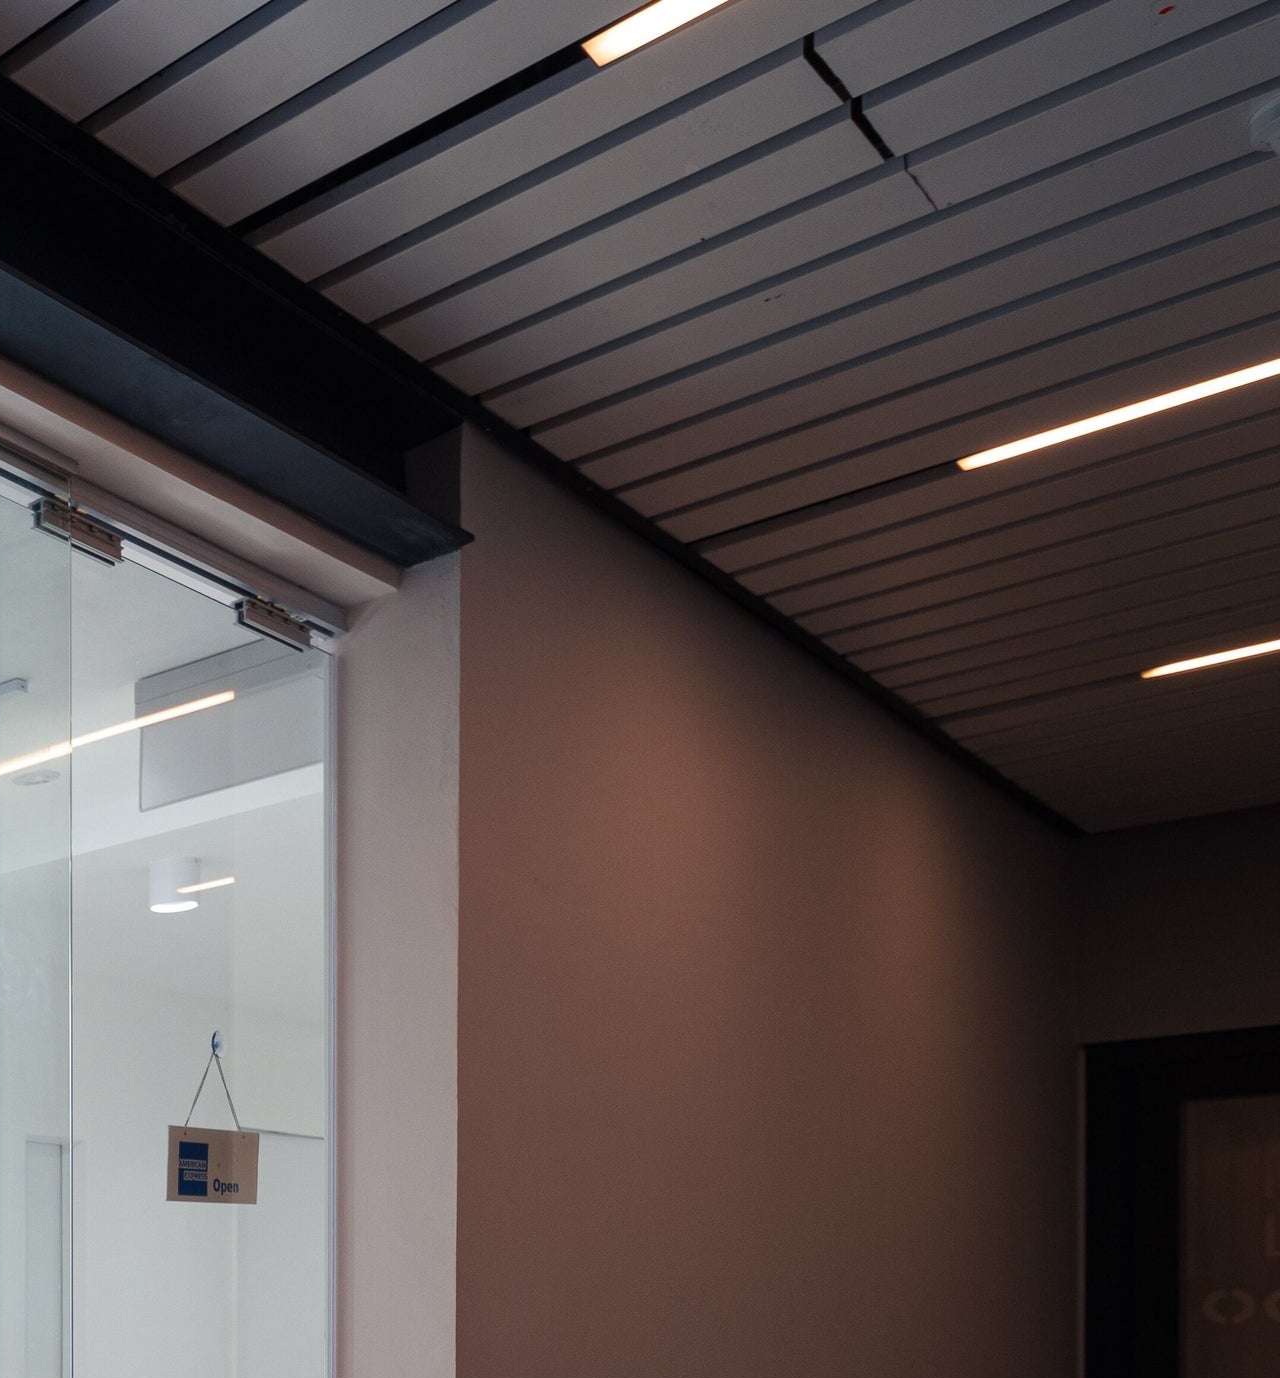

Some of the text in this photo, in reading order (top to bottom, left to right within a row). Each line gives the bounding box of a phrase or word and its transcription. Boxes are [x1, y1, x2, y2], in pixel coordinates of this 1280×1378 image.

[178, 1160, 206, 1169] AMERICAN
[184, 1171, 208, 1180] EXPRESS
[213, 1179, 239, 1195] Open
